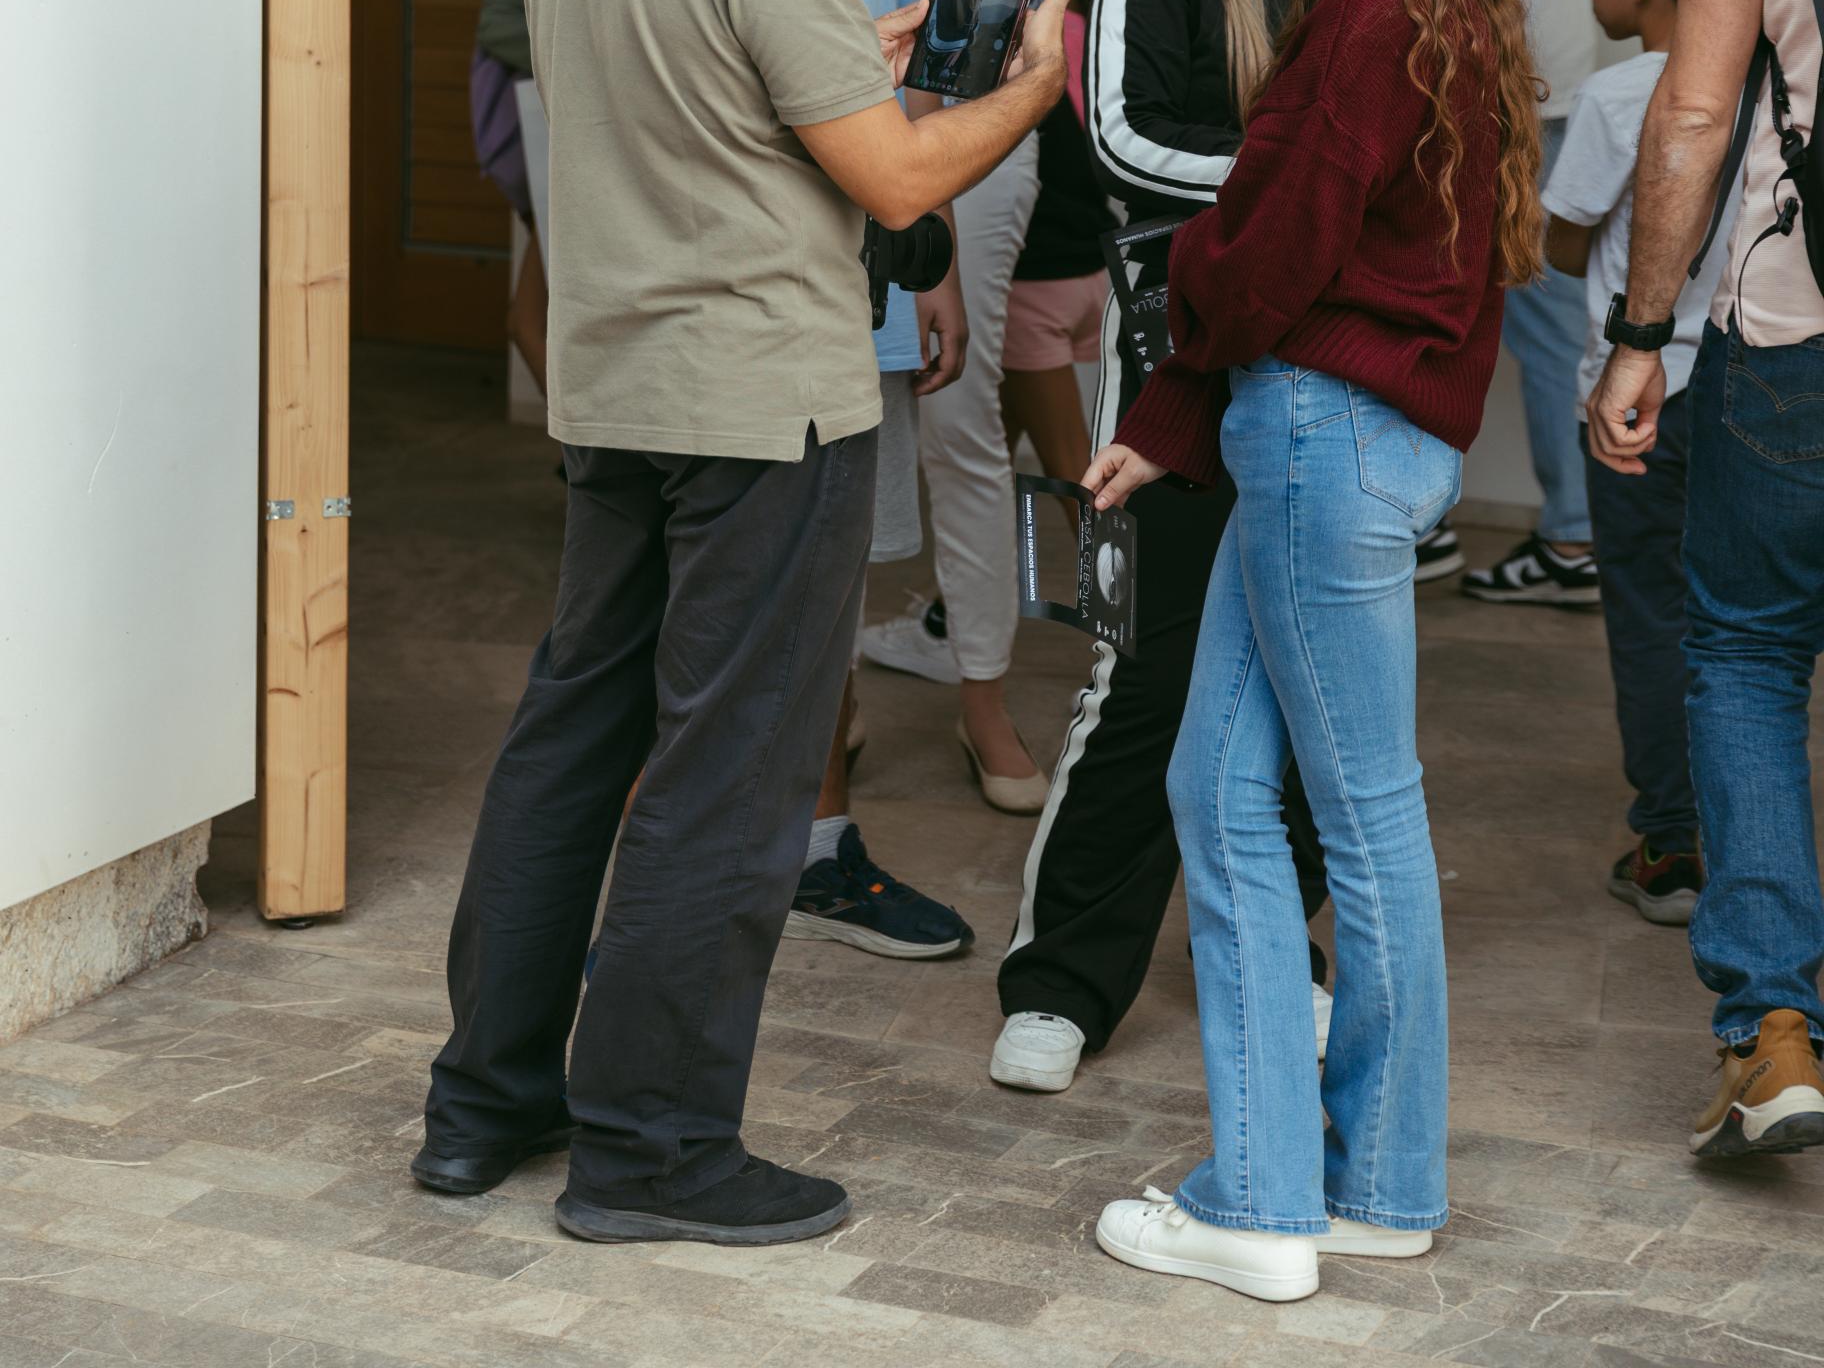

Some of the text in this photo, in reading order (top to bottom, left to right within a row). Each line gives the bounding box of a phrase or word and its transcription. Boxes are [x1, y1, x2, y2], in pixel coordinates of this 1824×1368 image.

[1130, 293, 1168, 314] BOLLA
[1027, 538, 1035, 569] ESPACIOS
[1082, 504, 1092, 618] CASA CEBOLLA
[1028, 570, 1036, 601] HUMANOS
